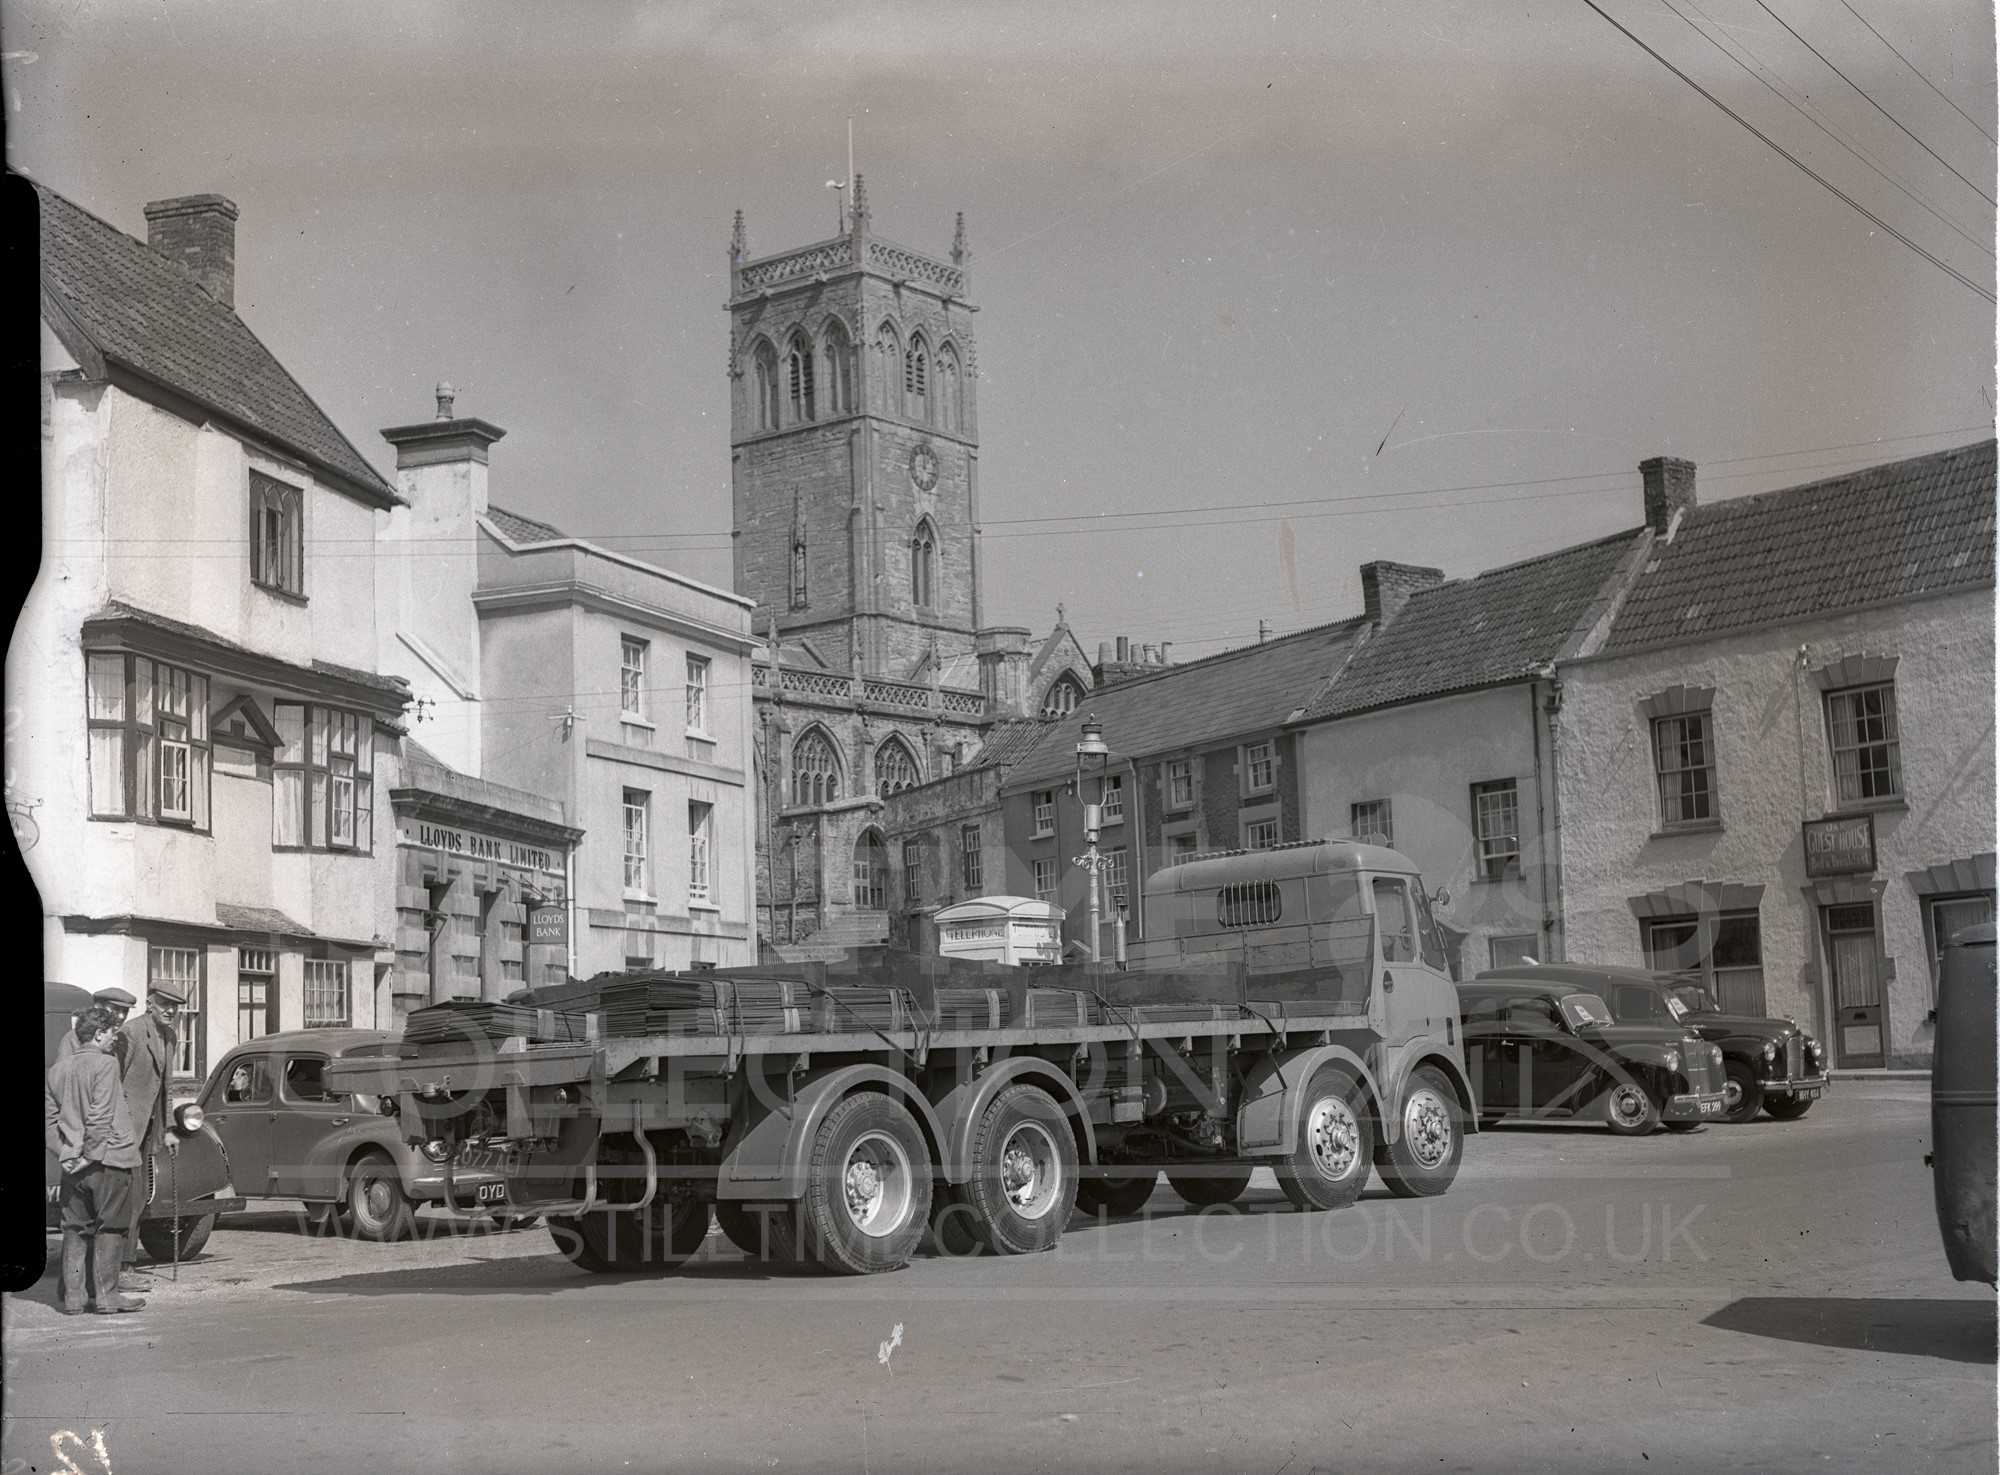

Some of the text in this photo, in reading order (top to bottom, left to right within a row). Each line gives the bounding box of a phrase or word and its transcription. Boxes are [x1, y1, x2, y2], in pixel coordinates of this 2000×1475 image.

[1807, 822, 1870, 854] GUEST HOUSE
[420, 825, 550, 871] LLOYDS BANK LIMITED
[533, 915, 565, 925] LLOYDS
[536, 927, 561, 937] BANK
[946, 926, 1005, 941] TELEPHONE
[479, 1183, 505, 1200] OYD
